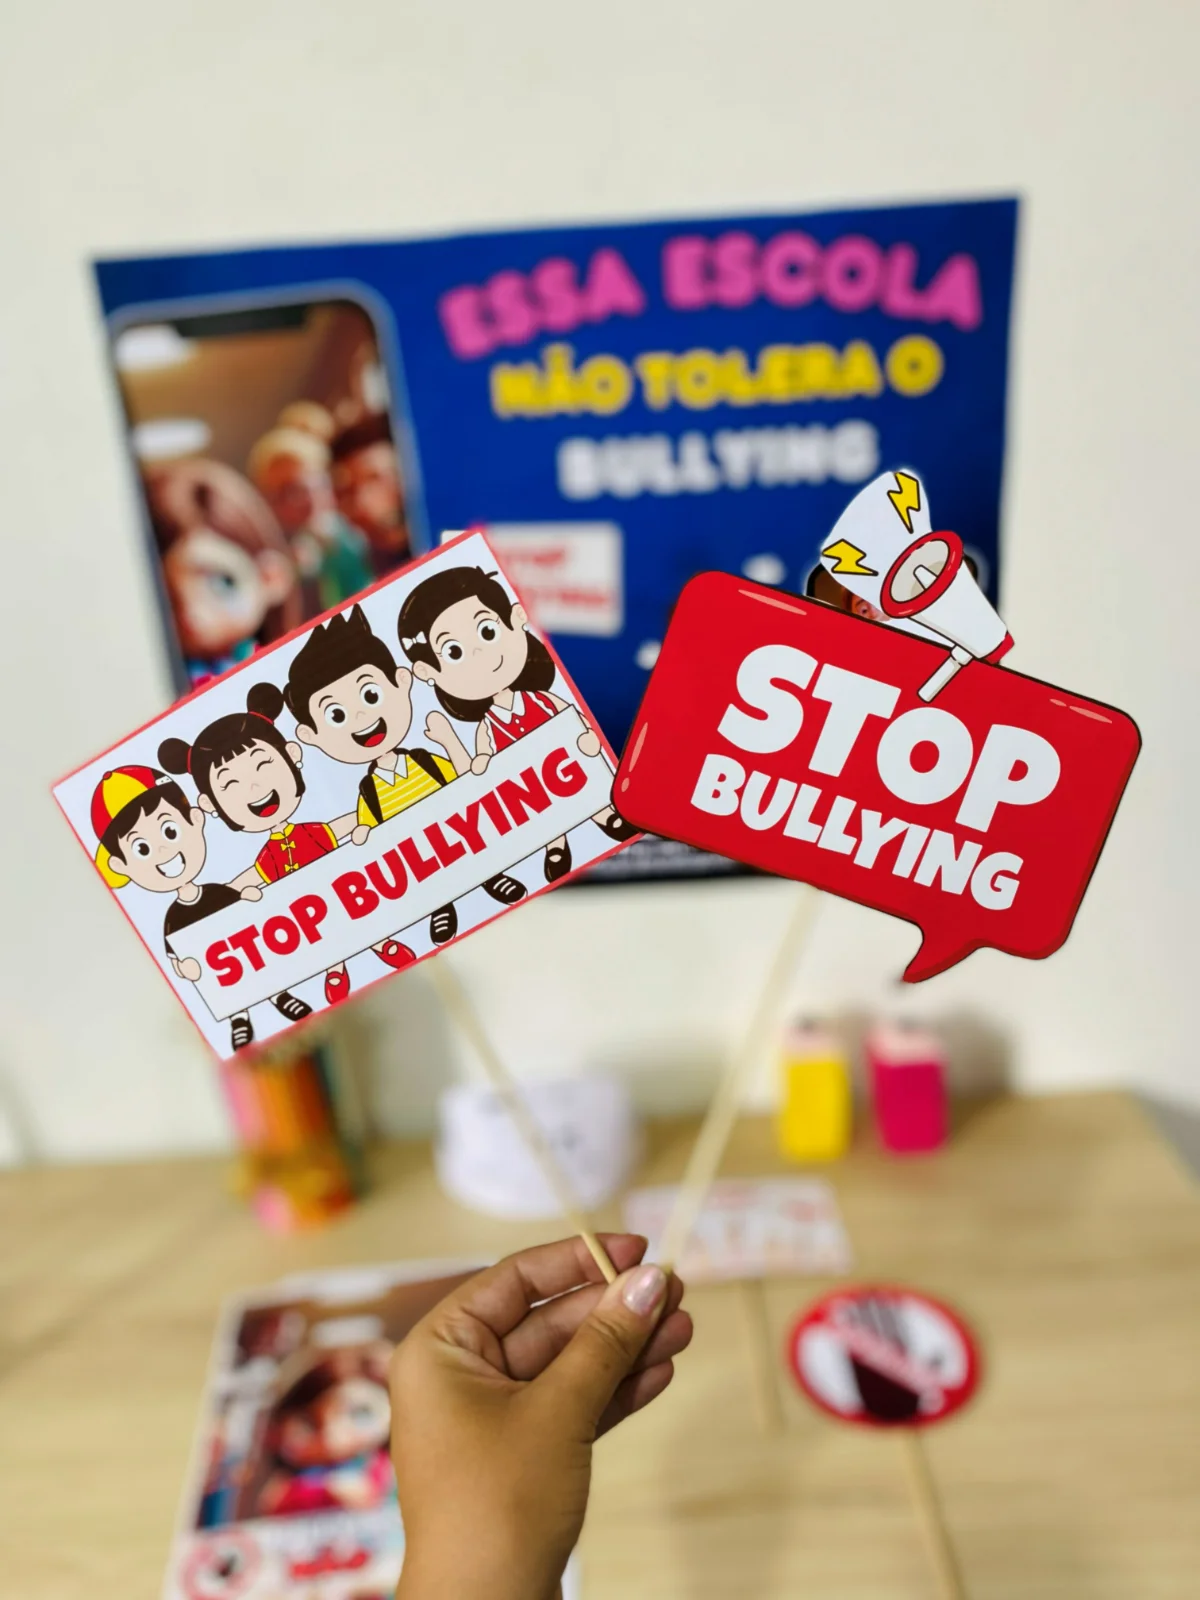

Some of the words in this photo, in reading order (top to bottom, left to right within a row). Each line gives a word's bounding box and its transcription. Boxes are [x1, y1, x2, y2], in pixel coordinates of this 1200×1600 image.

[440, 249, 645, 358] ESSA
[663, 232, 981, 329] ESCOLA
[490, 344, 633, 416] NÃO
[636, 341, 884, 410] TOLERA
[886, 335, 944, 396] O
[557, 420, 879, 499] BULLYING
[717, 644, 1061, 833] STOP
[205, 894, 329, 987] STOP
[331, 747, 588, 921] BULLYING
[690, 753, 1021, 911] BULLYING
